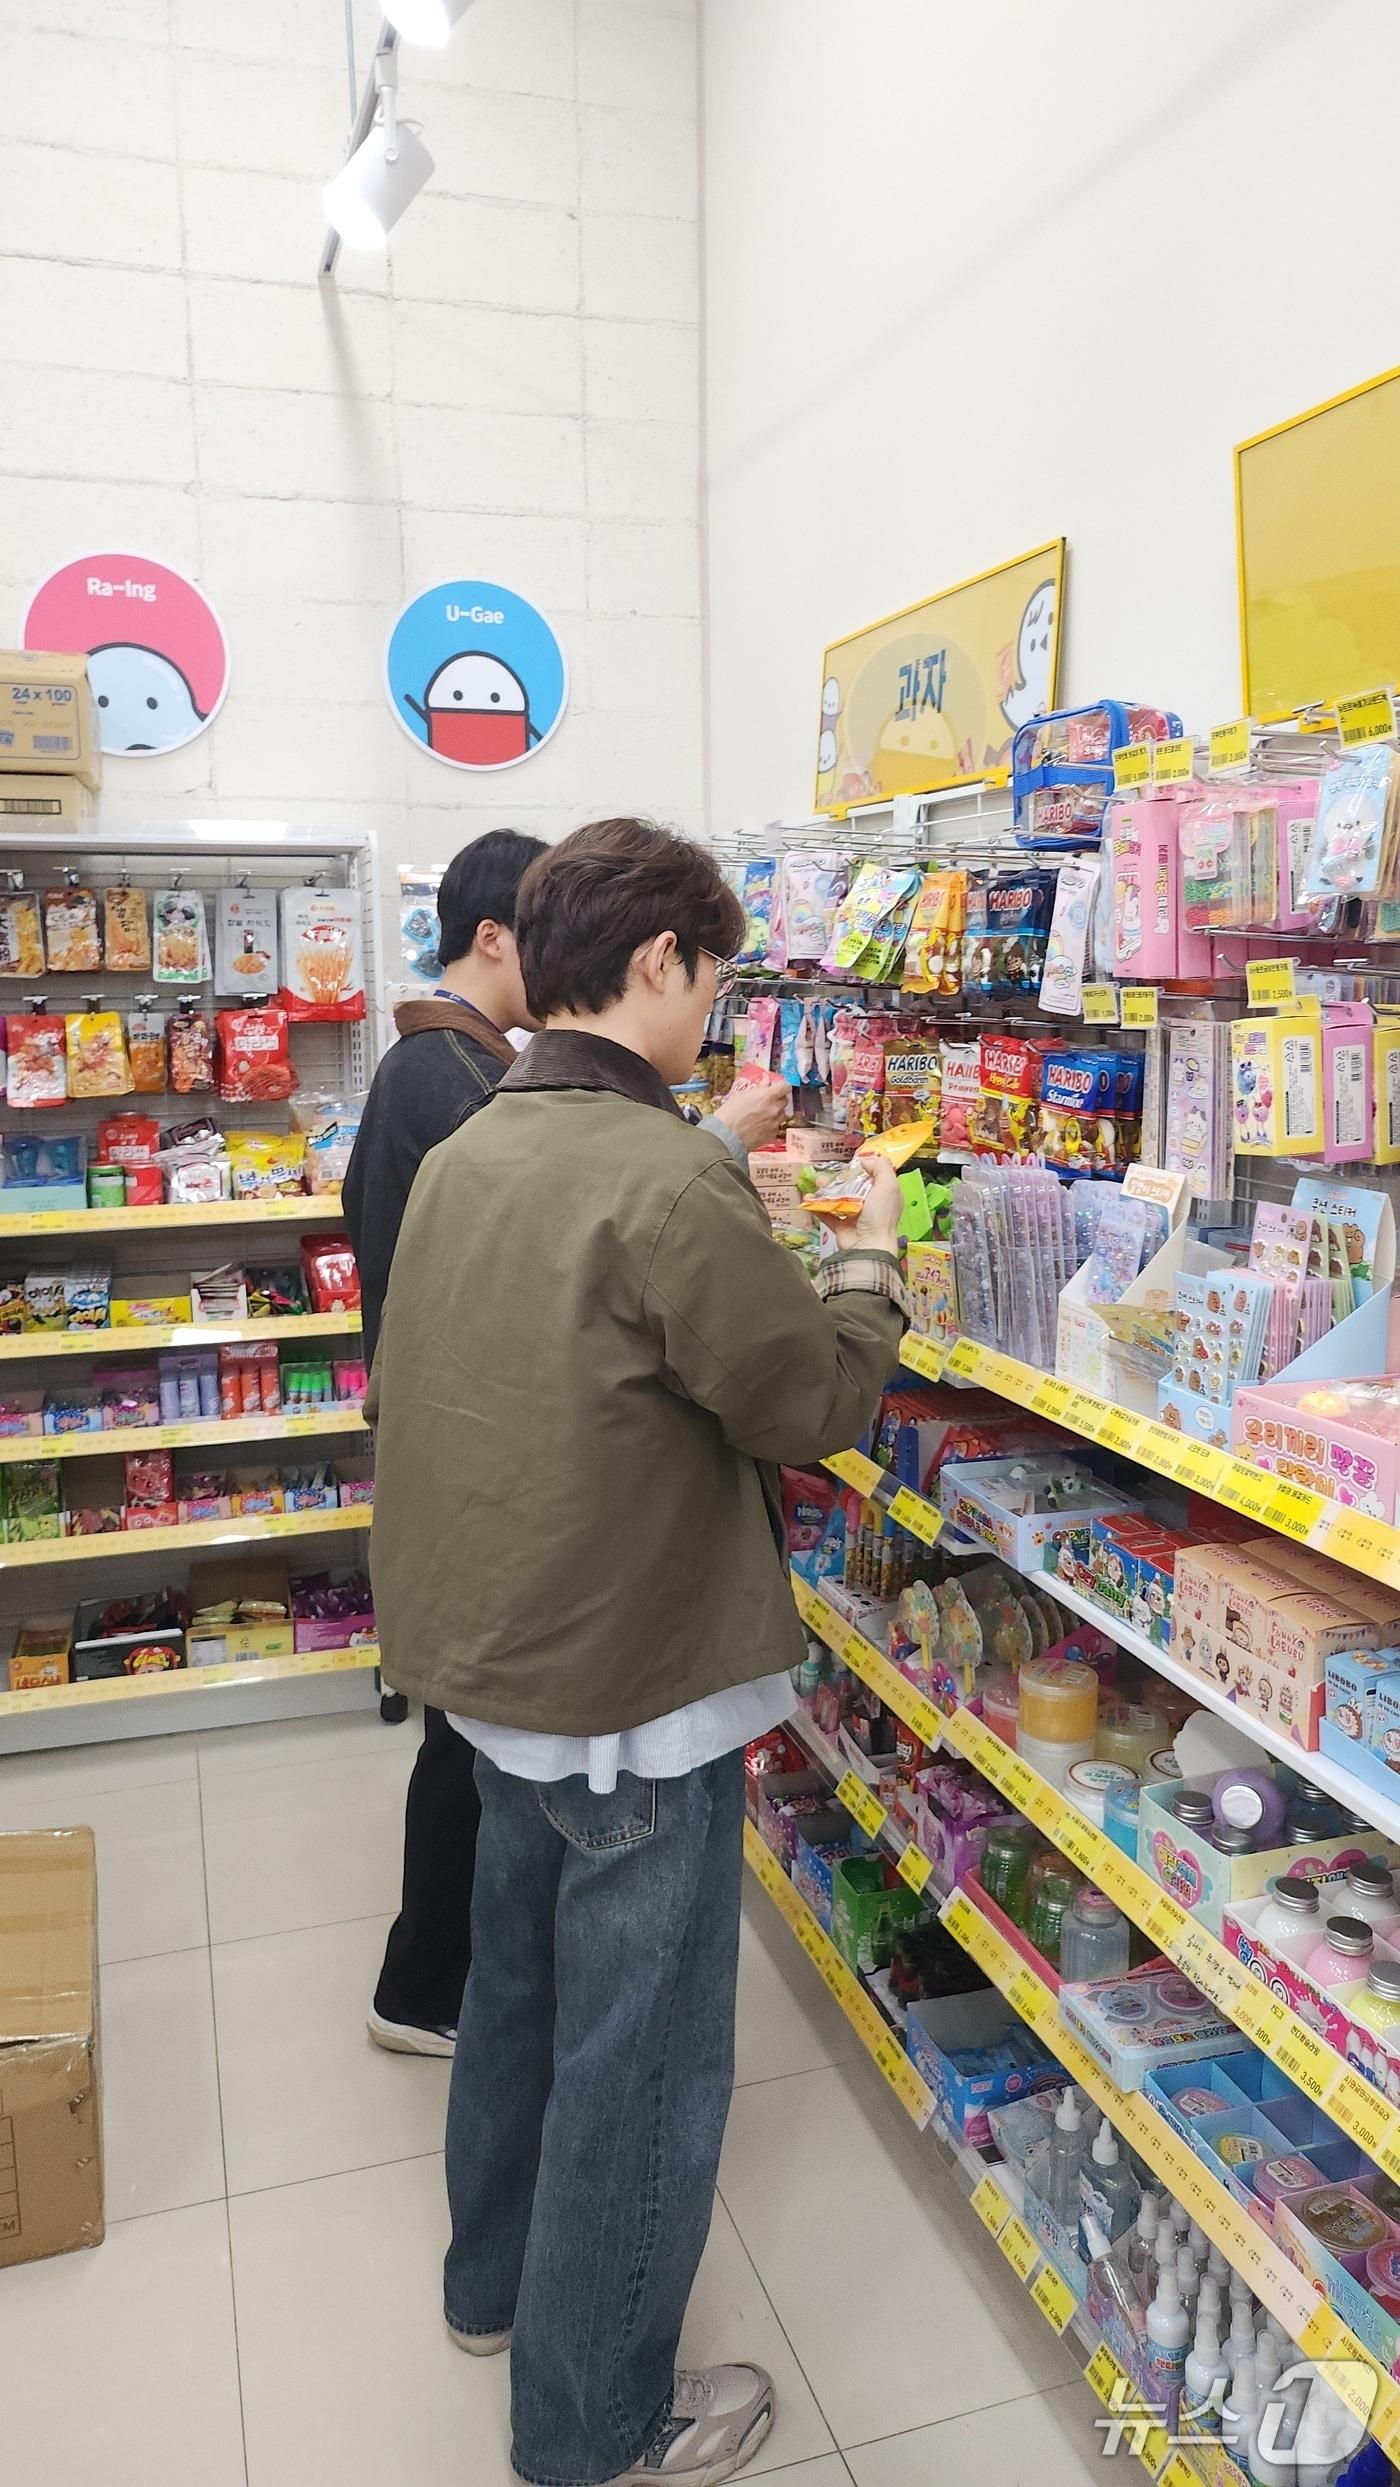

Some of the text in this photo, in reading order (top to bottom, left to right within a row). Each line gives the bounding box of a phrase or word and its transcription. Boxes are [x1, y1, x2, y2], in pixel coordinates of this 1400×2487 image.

[446, 604, 505, 624] U-Gae
[12, 687, 30, 700] 24
[46, 689, 72, 702] 100
[895, 649, 947, 721] 과자
[989, 888, 1033, 911] HARIBO
[886, 1055, 938, 1071] HARIBO
[1047, 1065, 1093, 1093] HARIBO
[1312, 1197, 1357, 1218] 쿠션 스티커
[1272, 1621, 1298, 1646] FUNNY
[1271, 1635, 1305, 1661] LABUBU
